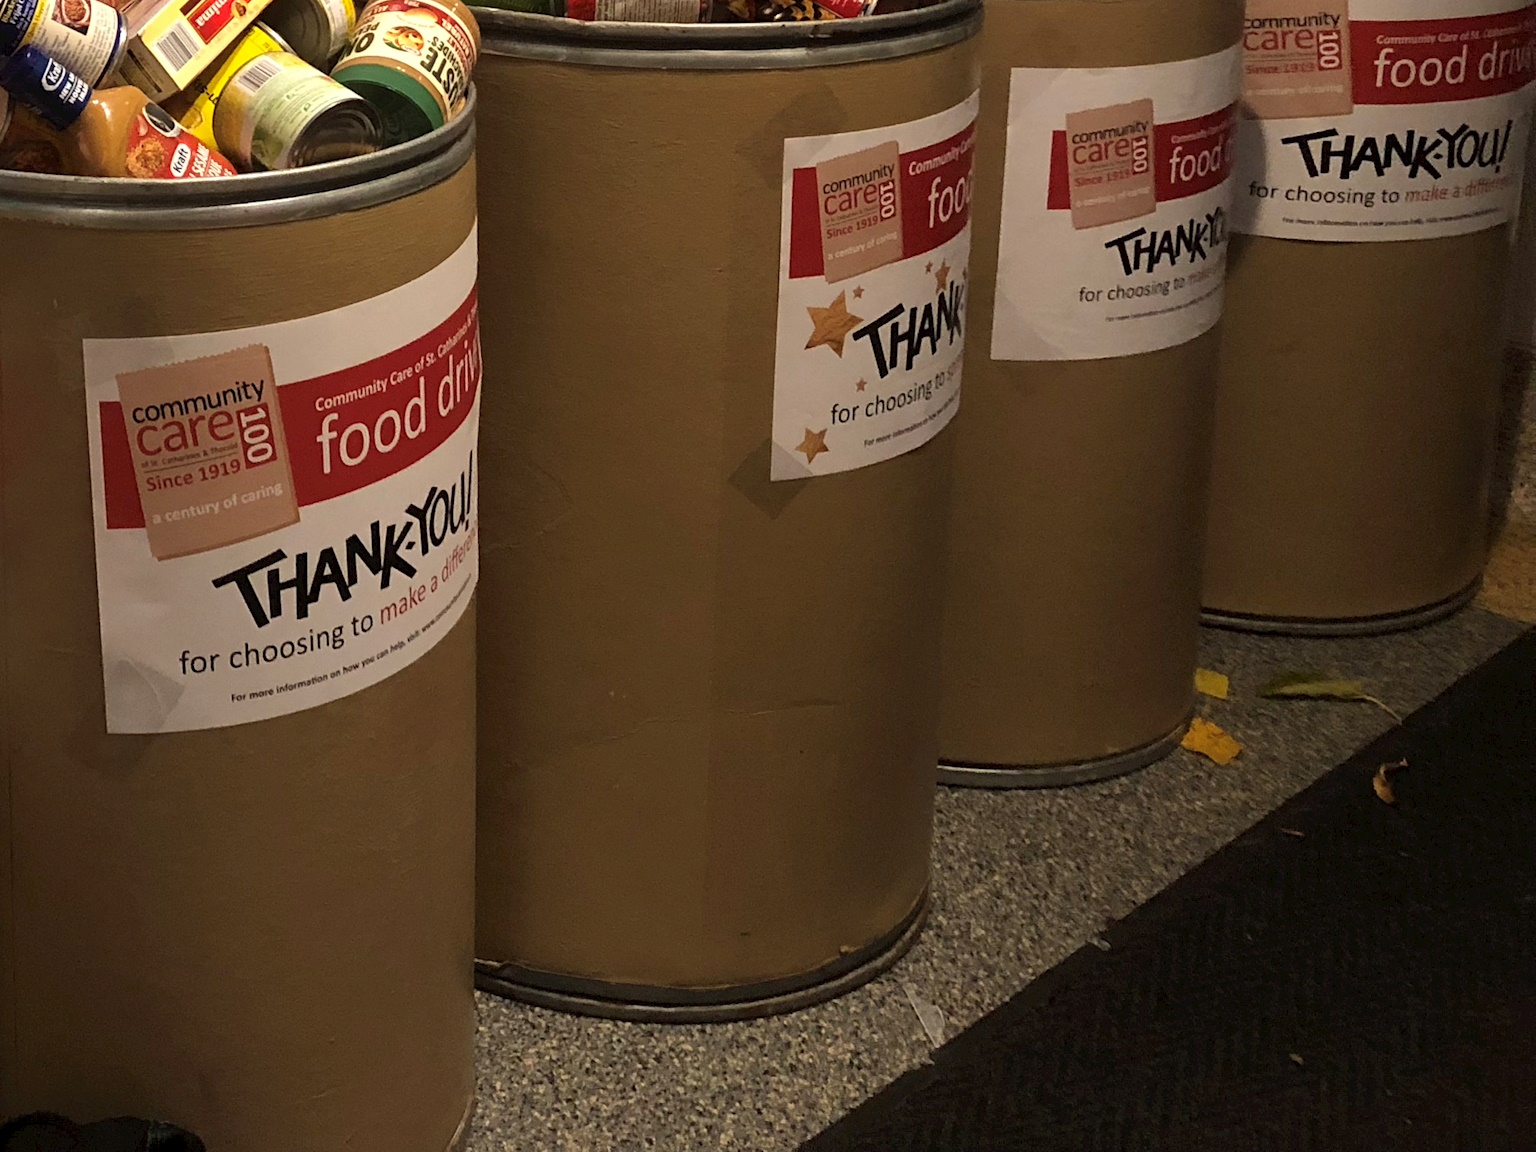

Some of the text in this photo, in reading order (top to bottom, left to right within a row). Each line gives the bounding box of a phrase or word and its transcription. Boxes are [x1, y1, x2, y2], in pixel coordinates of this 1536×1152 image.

[1243, 29, 1314, 51] care
[1319, 33, 1340, 68] 100
[1375, 34, 1436, 45] Community
[1437, 32, 1458, 43] Care
[1373, 43, 1468, 88] food
[1072, 120, 1149, 145] community
[1072, 137, 1130, 165] care
[1280, 119, 1513, 180] THANK-YOU!
[173, 148, 189, 174] Kraft
[908, 146, 960, 176] Community
[1132, 137, 1148, 173] 100
[1169, 133, 1223, 184] food
[822, 162, 895, 195] community
[1248, 182, 1279, 199] for
[1284, 186, 1376, 208] choosing
[1381, 188, 1400, 204] to
[1404, 183, 1449, 203] make
[824, 182, 878, 216] care
[880, 180, 895, 219] 100
[826, 214, 879, 240] Since 1919
[1079, 286, 1103, 302] for
[1107, 280, 1171, 301] choosing
[315, 376, 389, 412] Community
[389, 366, 413, 386] Care
[414, 355, 425, 373] of
[425, 351, 437, 367] St.
[830, 403, 860, 425] for
[865, 382, 933, 418] choosing
[934, 370, 945, 390] to
[132, 379, 265, 424] community
[136, 410, 236, 457] care
[239, 407, 274, 464] 100
[316, 375, 427, 475] food
[146, 458, 242, 492] Since 1919
[151, 482, 284, 525] a century of caring
[211, 449, 474, 629] THANK-YOU!
[179, 650, 220, 676] for
[228, 625, 345, 670] choosing
[350, 612, 374, 637] to
[379, 580, 427, 625] make
[429, 575, 439, 594] a
[230, 692, 247, 704] For
[249, 687, 274, 700] more
[276, 673, 329, 695] information
[329, 669, 342, 680] on
[342, 661, 360, 676] how
